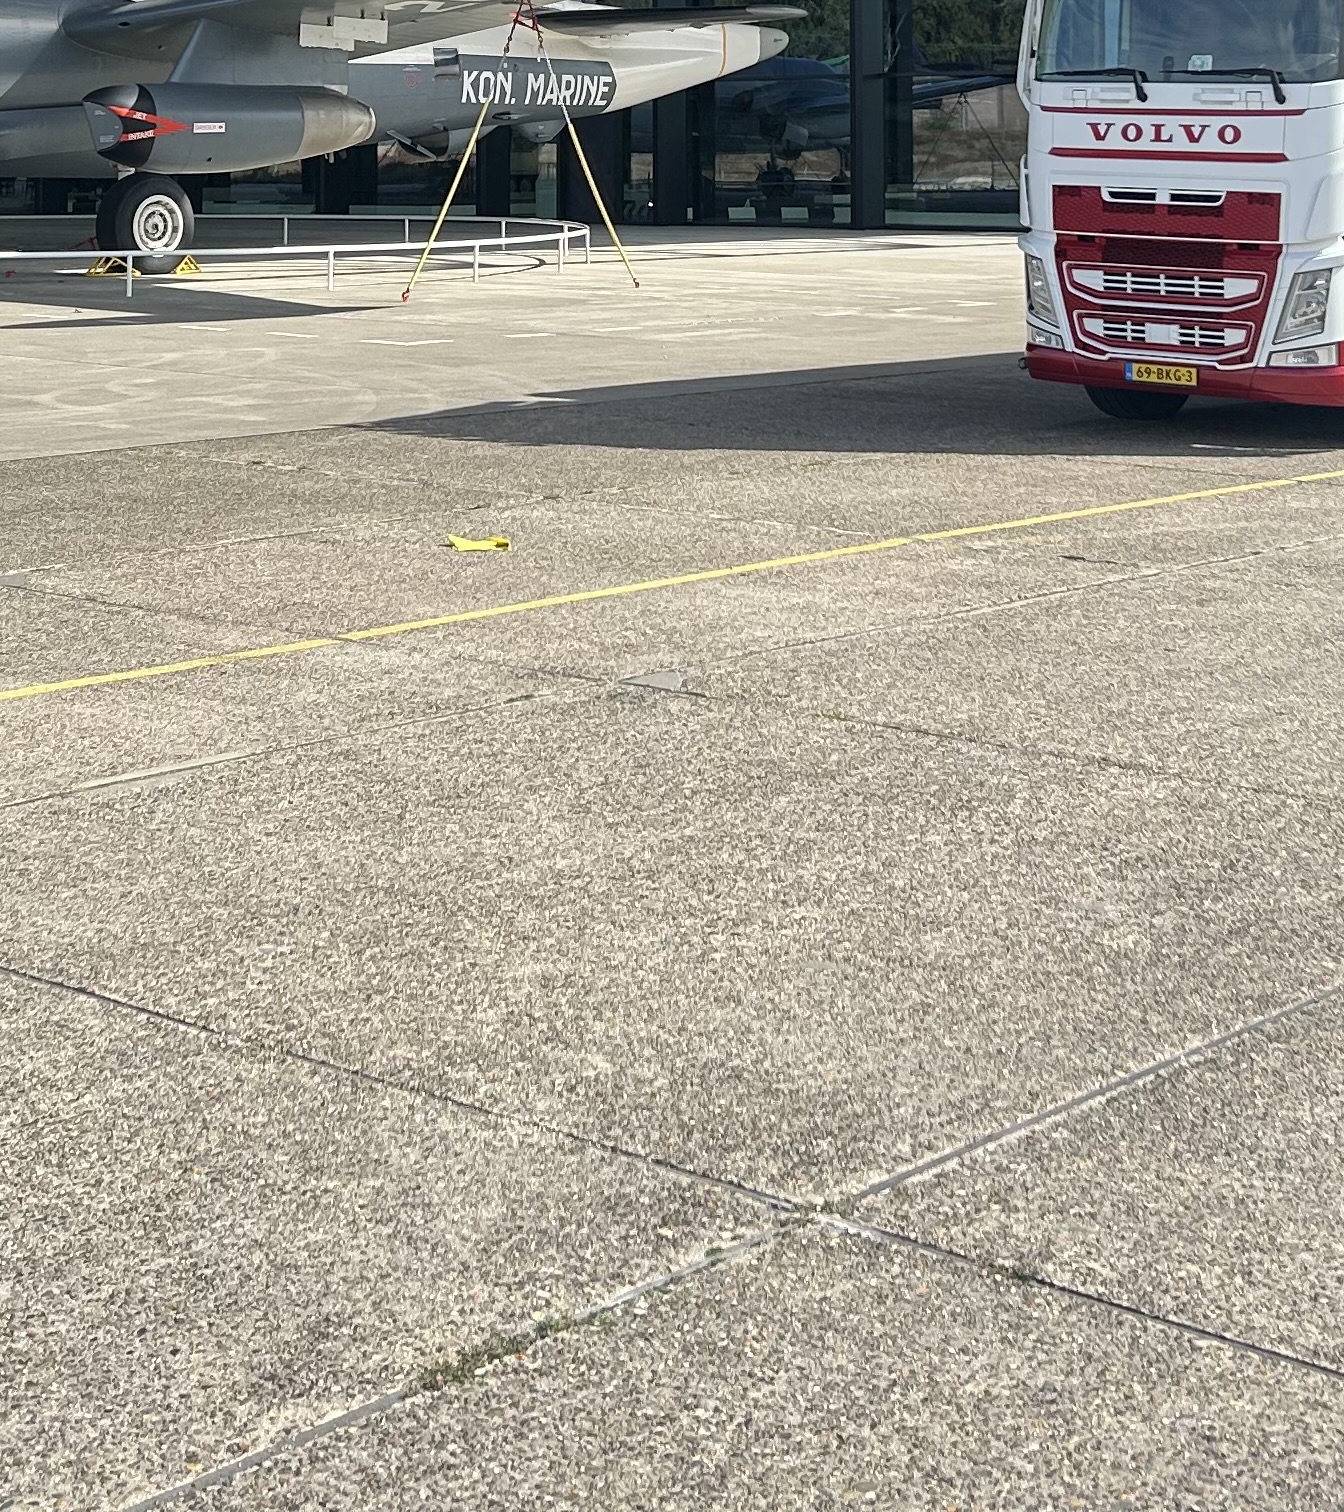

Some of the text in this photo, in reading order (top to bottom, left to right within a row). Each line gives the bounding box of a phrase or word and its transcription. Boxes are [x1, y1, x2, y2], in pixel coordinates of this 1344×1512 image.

[461, 70, 613, 106] KON. MARINE
[1086, 122, 1242, 145] VOLVO
[1136, 366, 1193, 383] 69-BKG-3
